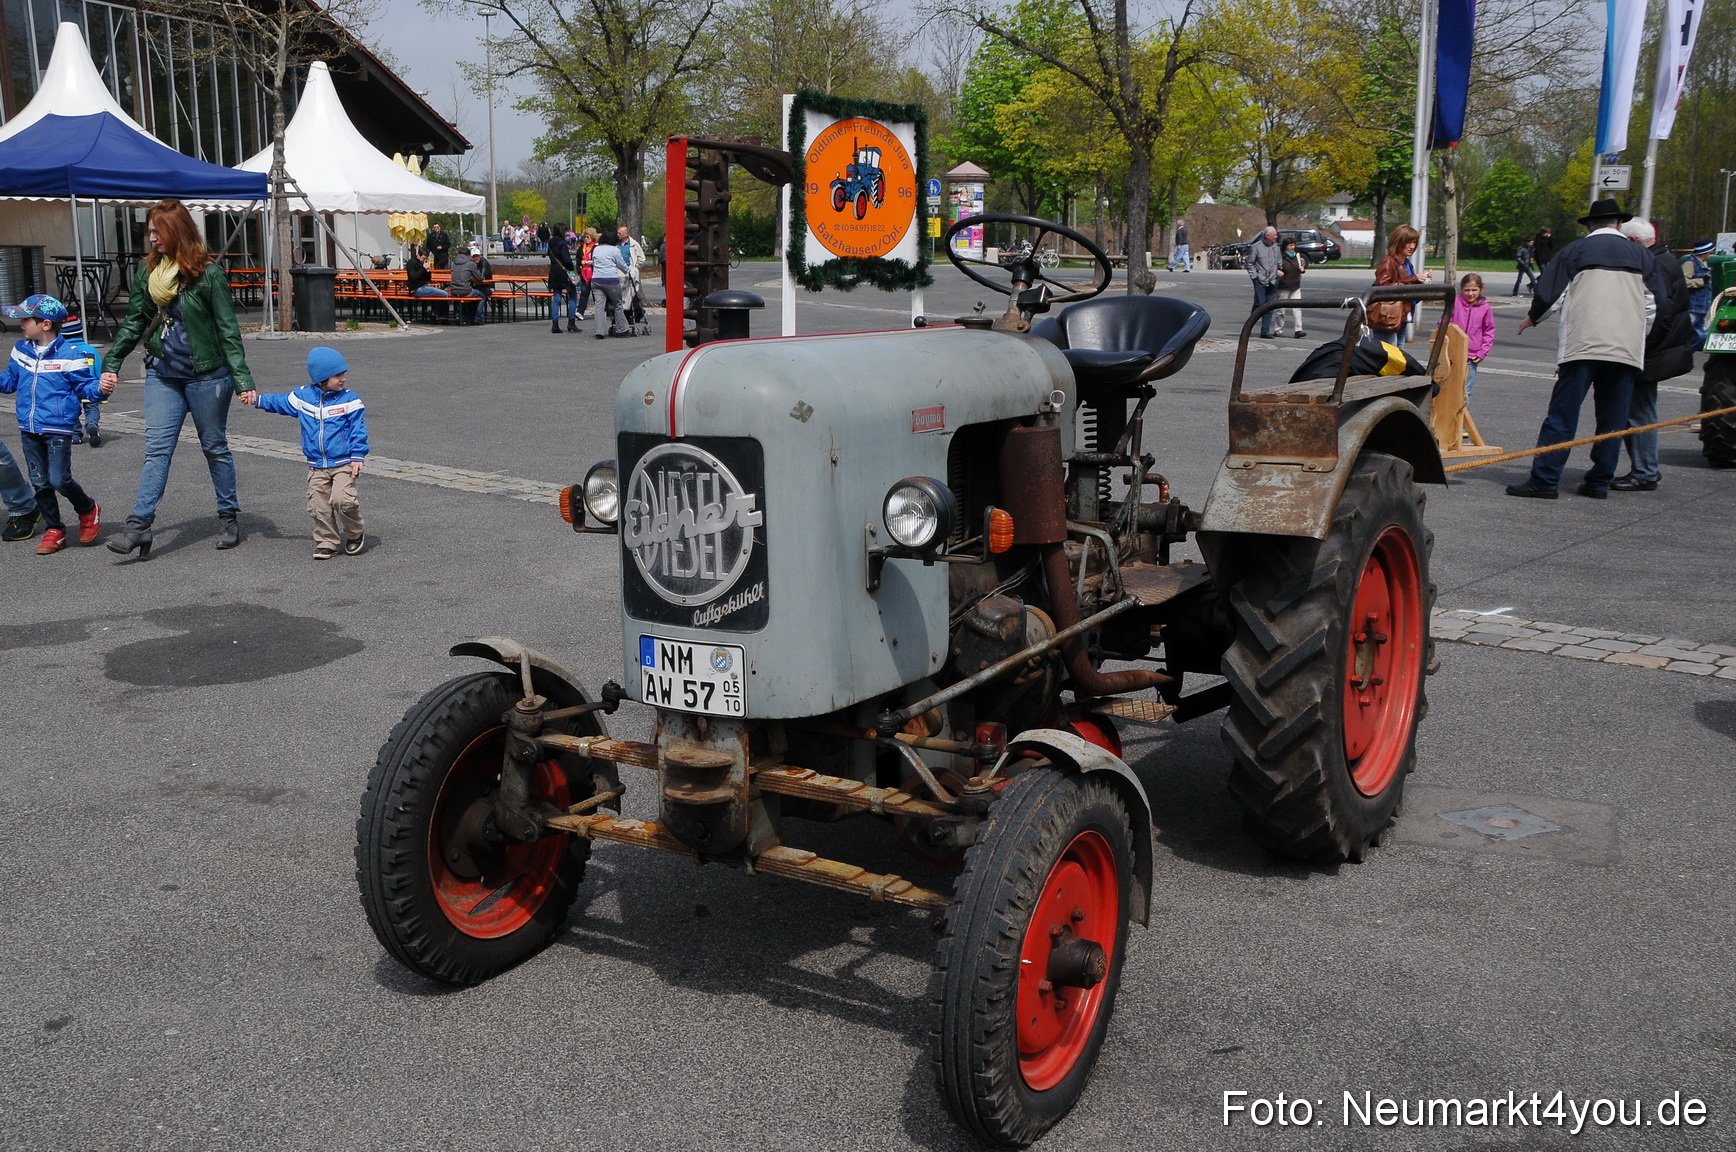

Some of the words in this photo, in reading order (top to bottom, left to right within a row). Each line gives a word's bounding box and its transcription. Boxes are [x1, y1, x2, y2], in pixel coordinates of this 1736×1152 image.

[809, 121, 894, 164] Oldtimer-Freunde
[893, 145, 909, 170] Jura
[805, 183, 819, 195] 19
[897, 187, 913, 198] 96
[816, 222, 903, 255] Batzhausen/Opf.
[624, 493, 763, 549] Eicher
[645, 655, 652, 665] D
[661, 642, 693, 675] NM
[645, 673, 673, 705] AW
[682, 679, 716, 711] 57
[723, 680, 740, 693] 05
[725, 699, 741, 712] 10
